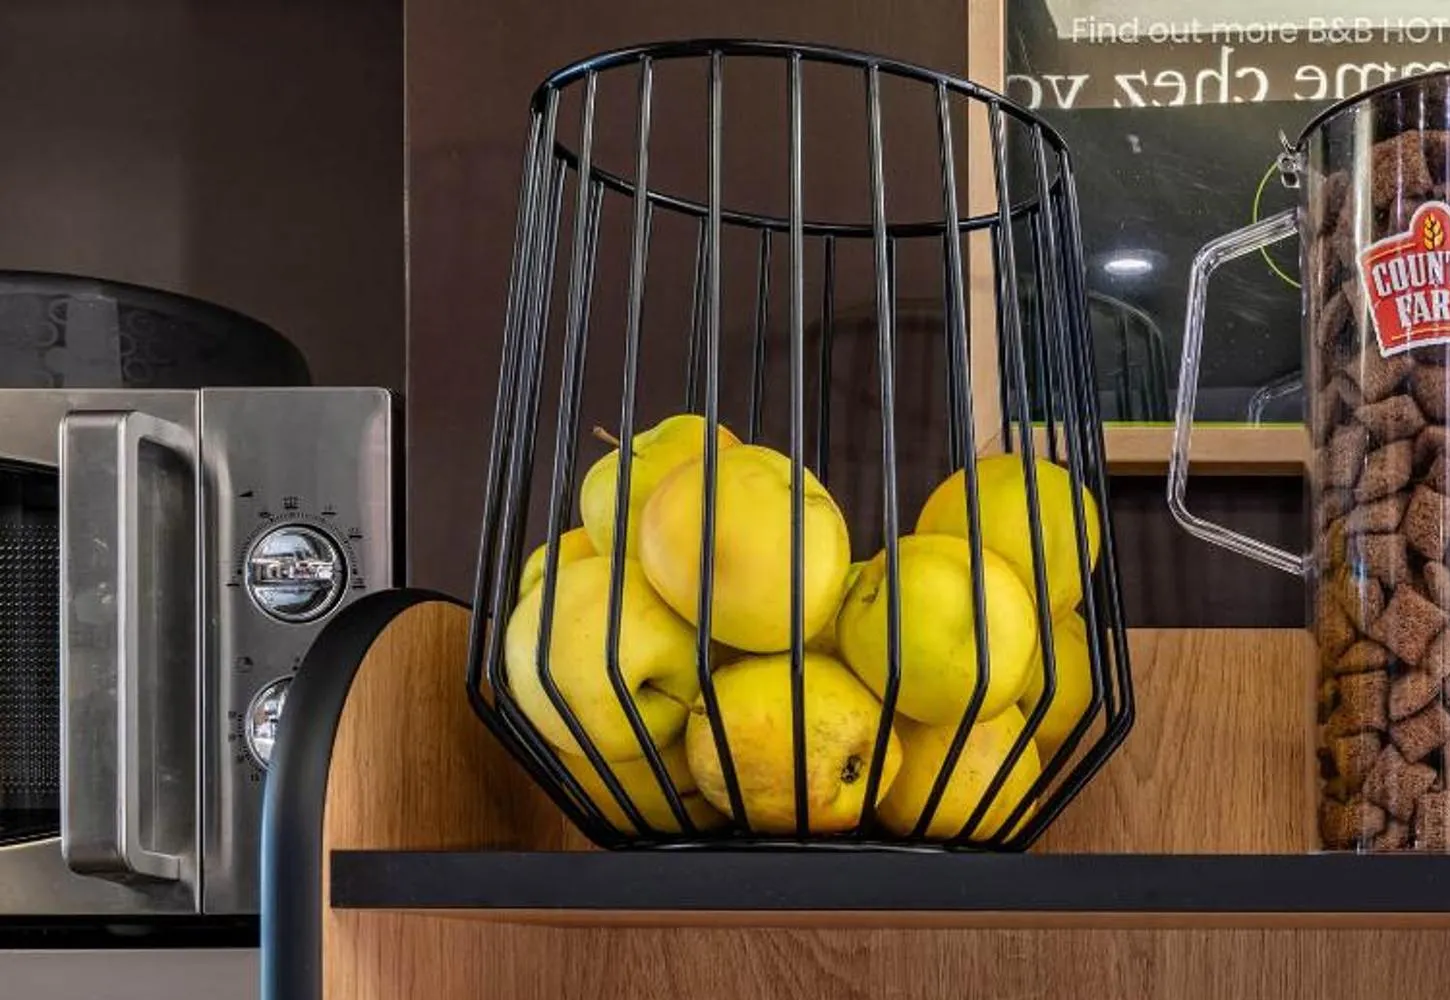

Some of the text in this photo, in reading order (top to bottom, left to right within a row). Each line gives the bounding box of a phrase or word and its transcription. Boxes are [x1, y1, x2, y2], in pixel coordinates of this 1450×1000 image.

[1072, 17, 1138, 43] Find
[1144, 20, 1204, 43] out
[1211, 21, 1298, 43] more
[1308, 17, 1374, 43] B&B
